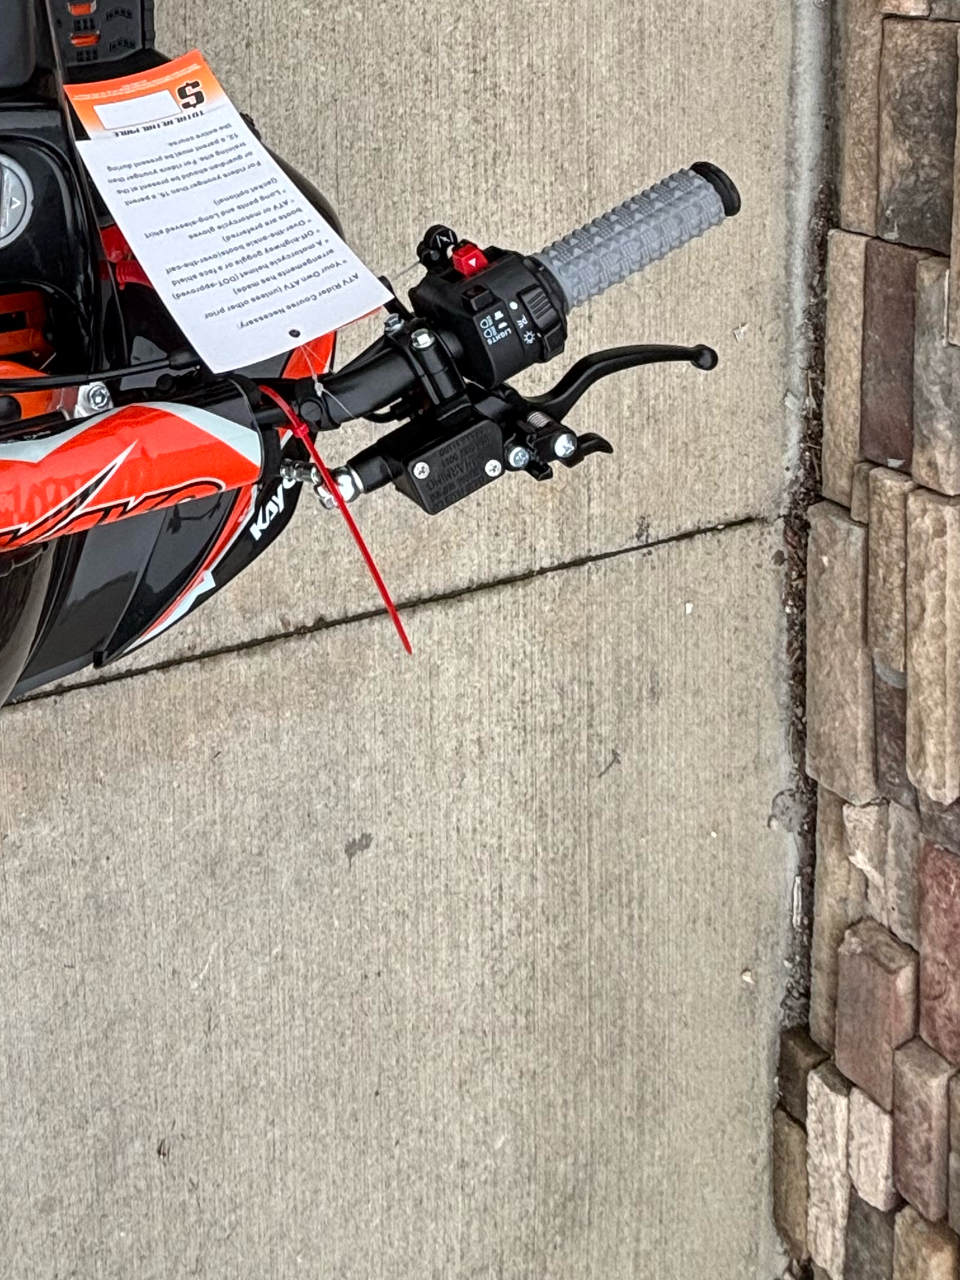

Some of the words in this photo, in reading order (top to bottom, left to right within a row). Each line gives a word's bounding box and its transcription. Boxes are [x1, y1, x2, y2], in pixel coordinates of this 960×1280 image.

[218, 122, 232, 130] the
[195, 128, 218, 139] entire
[194, 138, 219, 151] parent
[214, 141, 246, 156] training
[174, 147, 194, 157] must
[244, 150, 253, 158] or
[106, 163, 132, 172] during
[133, 155, 163, 168] present
[158, 163, 182, 173] riders
[209, 154, 243, 170] guardian
[247, 160, 261, 169] For
[126, 168, 158, 180] younger
[181, 167, 208, 180] should
[222, 166, 246, 178] riders
[139, 177, 169, 190] present
[189, 174, 221, 189] younger
[249, 177, 278, 192] (jacket
[170, 185, 189, 194] than
[259, 189, 281, 201] Long
[124, 195, 150, 206] parent
[213, 189, 249, 206] optional)
[236, 197, 259, 210] pants
[220, 207, 235, 216] and
[273, 199, 288, 211] ATV
[278, 207, 303, 220] boots
[165, 212, 220, 234] Long-sleeved
[216, 211, 261, 230] motorcycle
[264, 217, 277, 226] are
[143, 229, 164, 239] shirt
[187, 226, 215, 239] gloves
[221, 222, 263, 242] preferred)
[245, 219, 306, 247] Over-the-ankle
[264, 229, 314, 253] Off-highway
[234, 250, 263, 265] goggle
[269, 243, 315, 266] motorcycle
[277, 248, 334, 277] arrangements
[321, 261, 342, 273] Your
[198, 268, 217, 277] face
[239, 263, 269, 278] helmet
[300, 270, 321, 282] Own
[171, 274, 197, 286] shield
[260, 274, 277, 284] has
[283, 279, 300, 290] ATV
[342, 272, 359, 286] ATV
[171, 273, 239, 300] (DOT-approved)
[232, 281, 259, 295] made)
[318, 282, 342, 296] Rider
[250, 286, 282, 302] (unless
[227, 299, 249, 311] other
[285, 294, 317, 310] Course
[204, 306, 225, 319] prior
[486, 326, 513, 347] LIGHTS
[425, 455, 478, 492] WARNING
